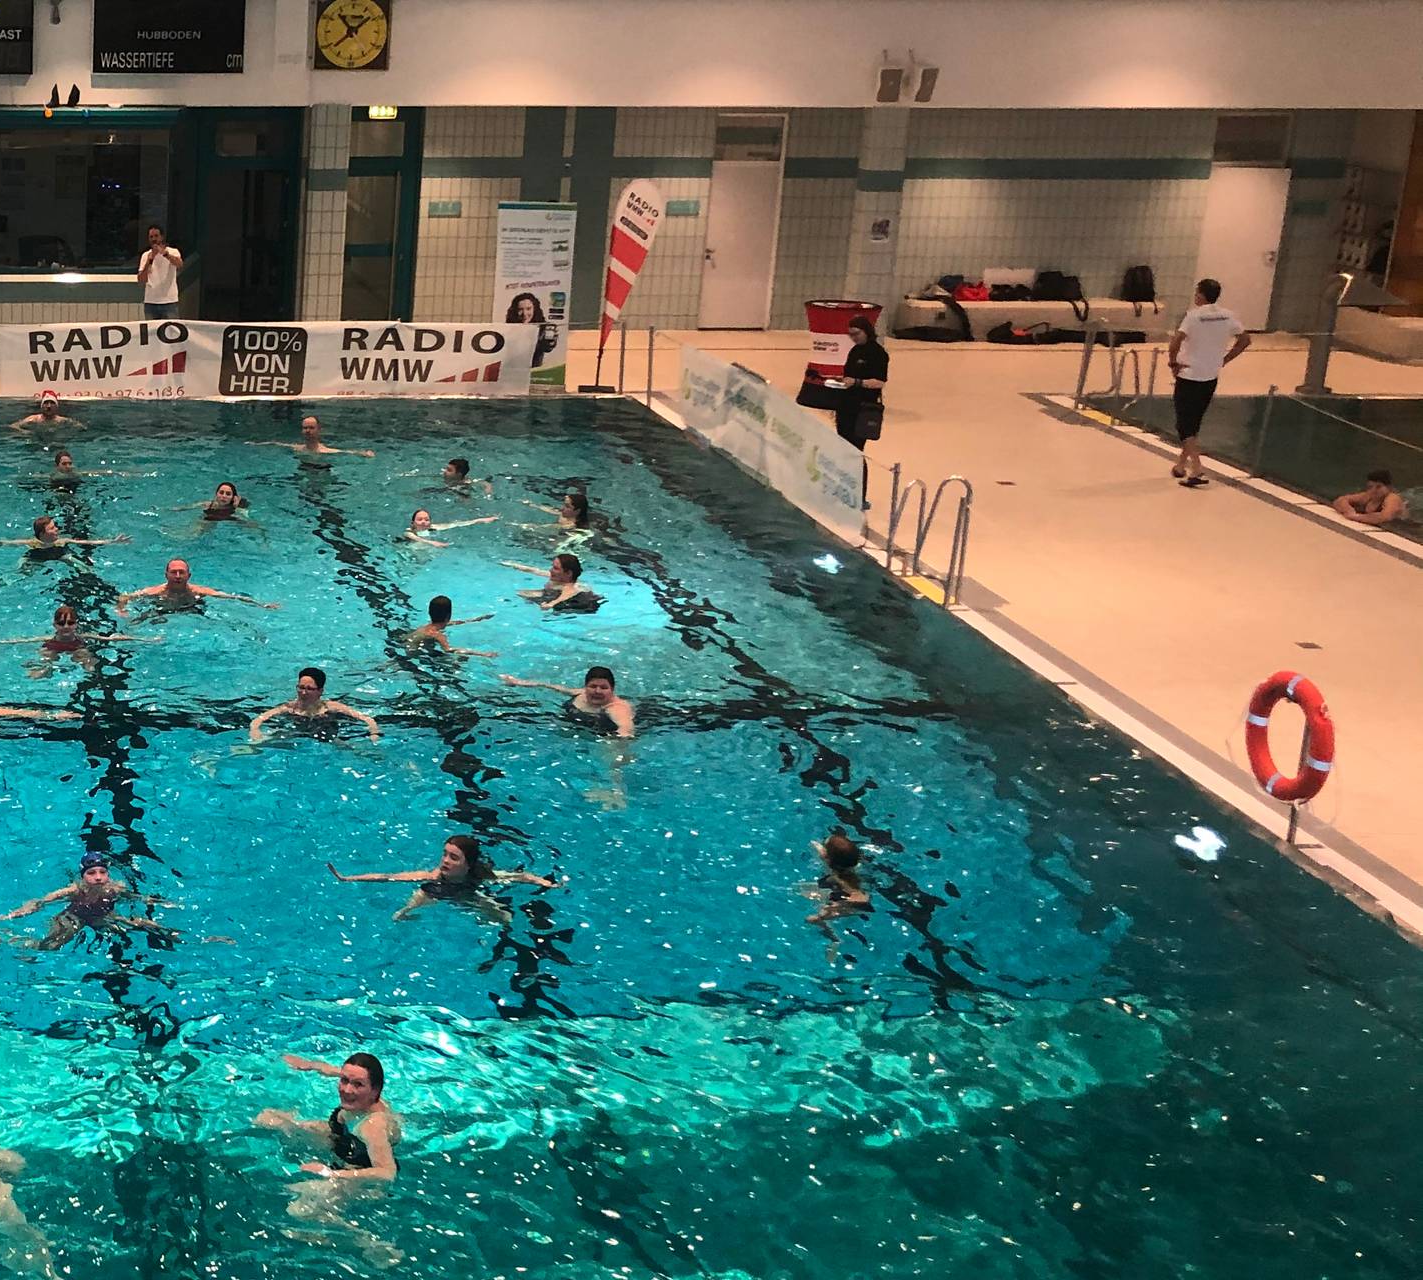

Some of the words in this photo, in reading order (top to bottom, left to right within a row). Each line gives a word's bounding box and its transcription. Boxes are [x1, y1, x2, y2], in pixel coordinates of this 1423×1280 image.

[137, 30, 202, 40] HUBBODEN
[100, 52, 175, 69] WASSERTIEFE
[226, 53, 243, 68] cm
[629, 191, 659, 218] RADIO
[29, 321, 189, 355] RADIO
[227, 329, 303, 352] 100%
[342, 327, 505, 355] RADIO
[30, 354, 123, 383] WMW
[233, 352, 291, 374] VON
[340, 357, 434, 382] WMW
[229, 374, 295, 394] HIER.
